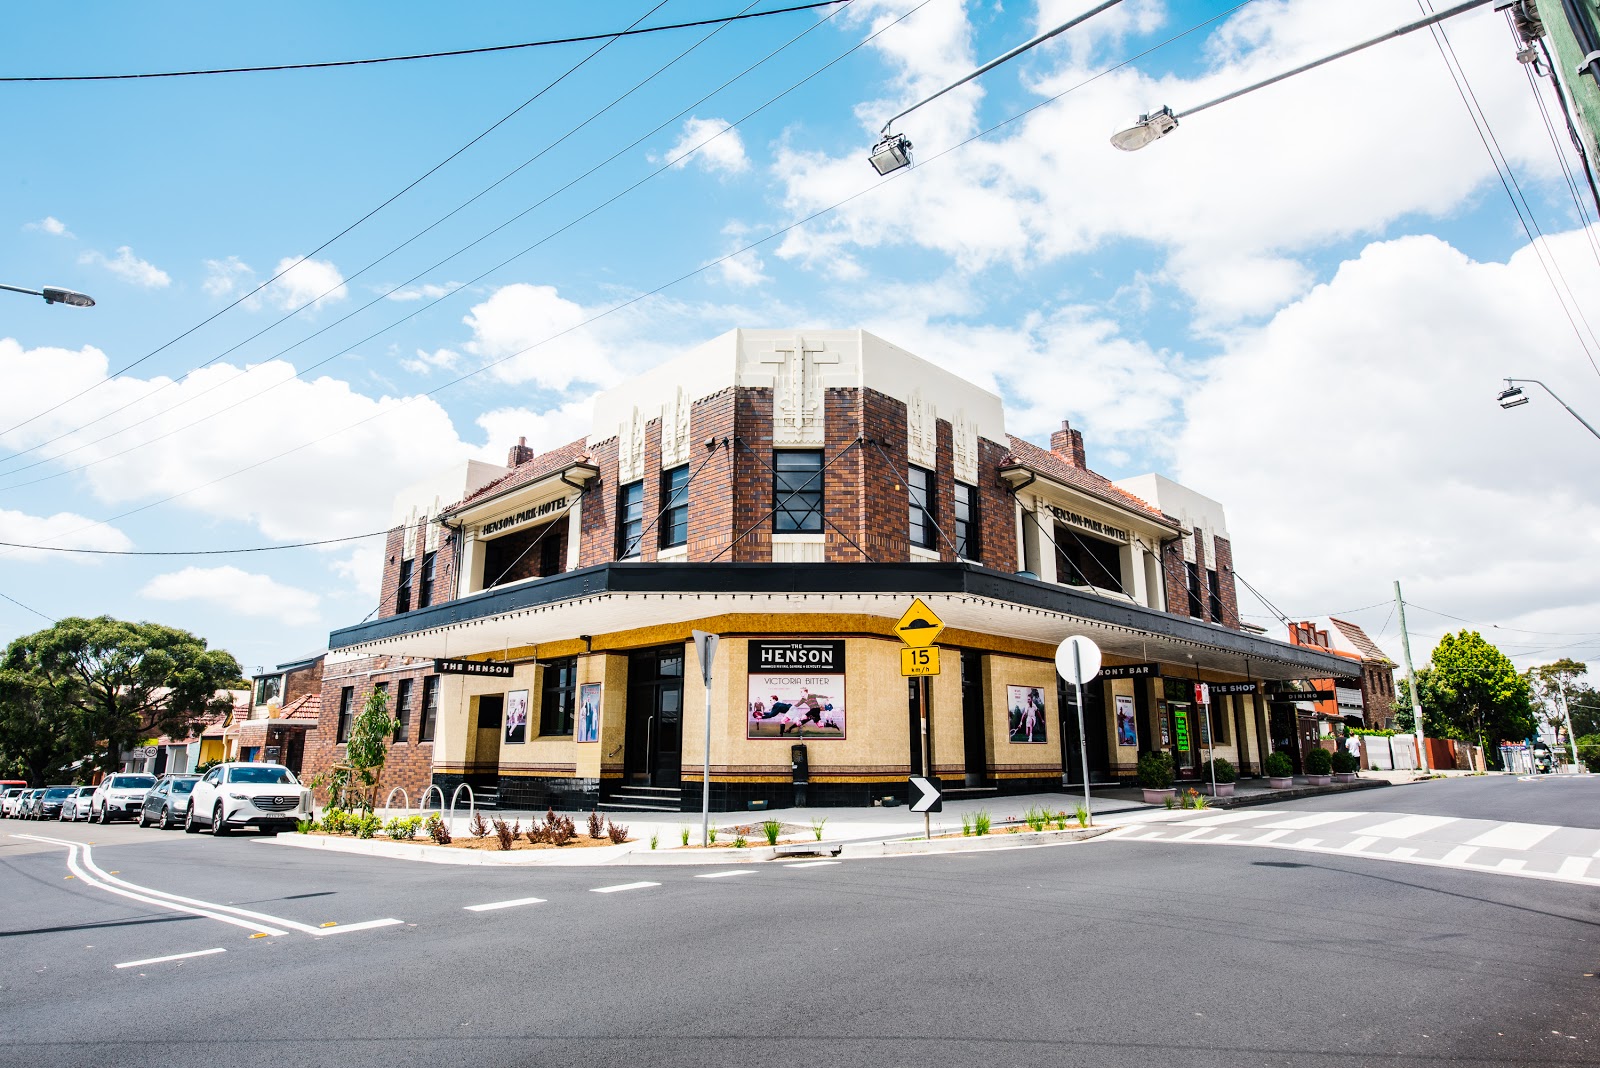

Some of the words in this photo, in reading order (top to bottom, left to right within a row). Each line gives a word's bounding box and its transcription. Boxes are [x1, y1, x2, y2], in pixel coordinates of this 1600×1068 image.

[761, 649, 833, 663] HENSON
[911, 649, 930, 665] 15
[442, 662, 463, 671] THE
[468, 664, 509, 674] HENSON
[911, 666, 930, 674] km/h
[1098, 668, 1124, 676] RONT
[1129, 666, 1149, 674] BAR
[763, 677, 802, 685] VICTORIA
[805, 677, 830, 685] BITTER
[1209, 685, 1227, 693] TLE
[1230, 684, 1256, 692] SHOP
